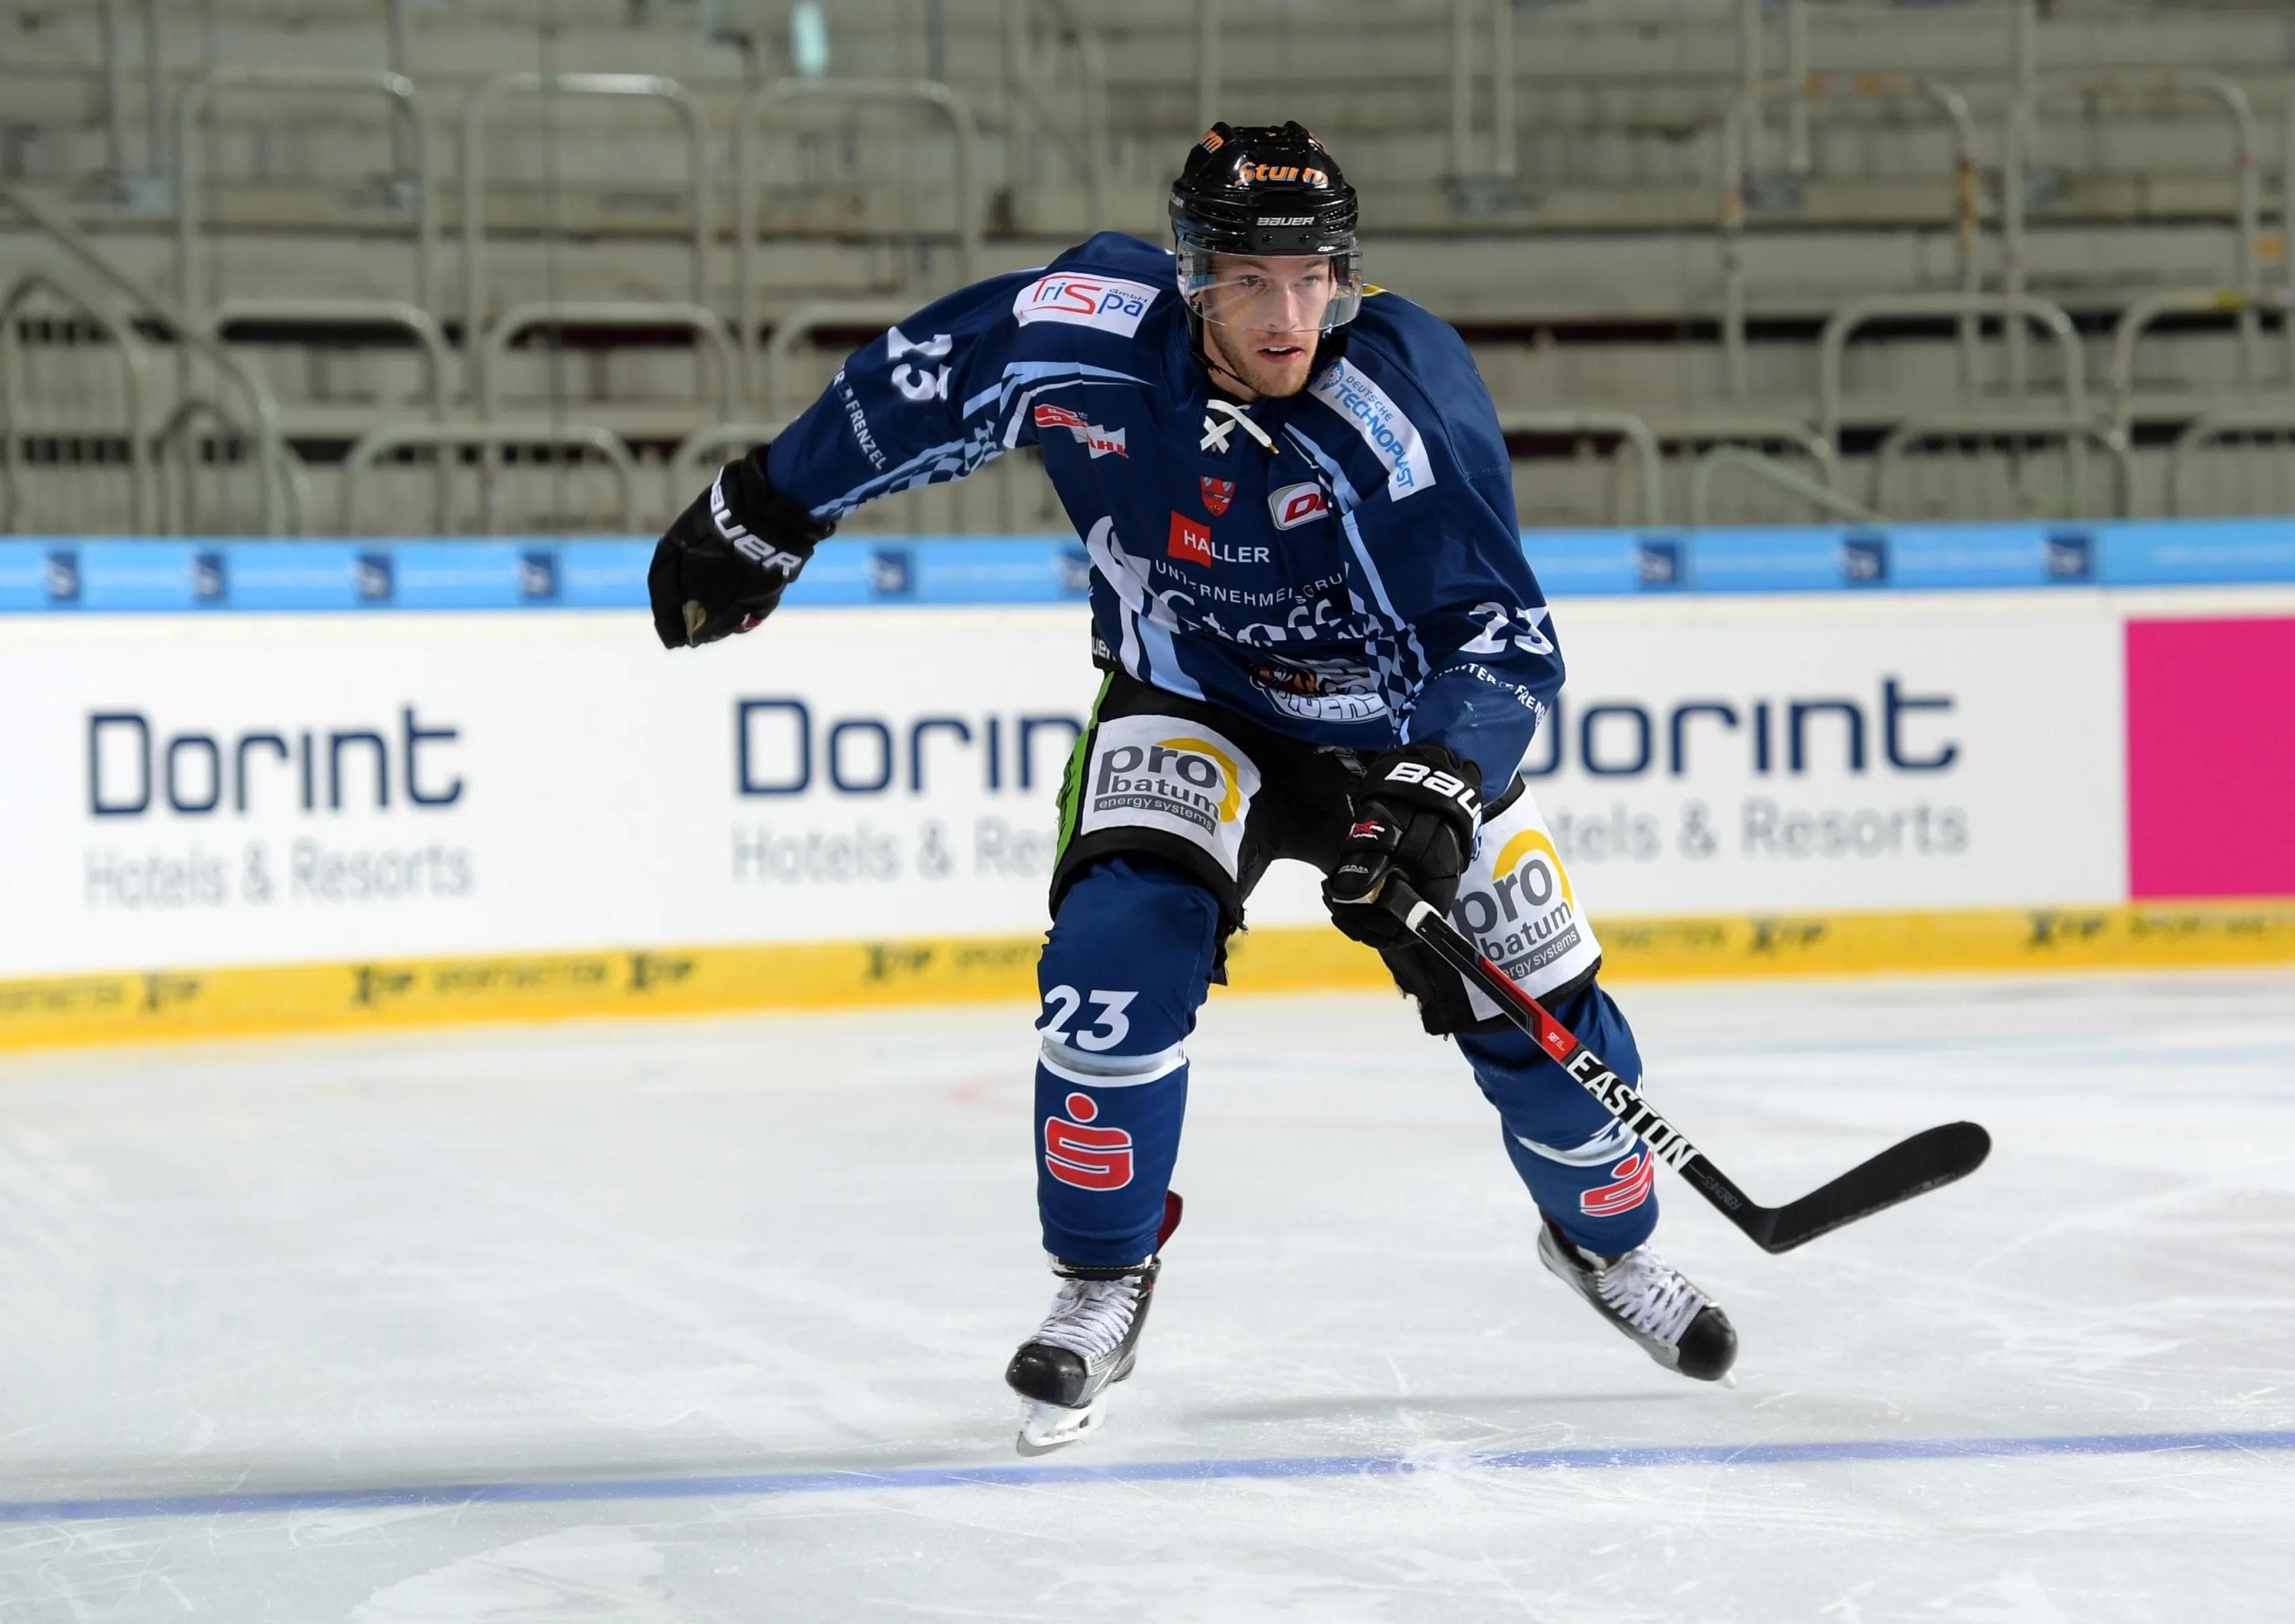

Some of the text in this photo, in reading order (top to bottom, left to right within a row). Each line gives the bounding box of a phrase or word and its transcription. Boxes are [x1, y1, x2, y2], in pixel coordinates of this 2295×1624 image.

[1345, 375, 1394, 422] DEUTSCHE
[846, 399, 887, 470] FRENZEL
[1333, 383, 1414, 489] TECHNOPLAST
[711, 466, 802, 577] AUER
[1184, 529, 1270, 563] HALLER
[87, 706, 463, 819] Dorint
[736, 697, 1085, 795] Dorin
[1096, 744, 1218, 796] pro
[1099, 796, 1213, 831] energy systems
[1111, 775, 1220, 820] batum
[1452, 859, 1553, 951] pro
[1480, 901, 1572, 962] batum
[1533, 930, 1577, 966] systems
[1038, 985, 1139, 1052] 23
[1567, 1050, 1700, 1172] EASTON
